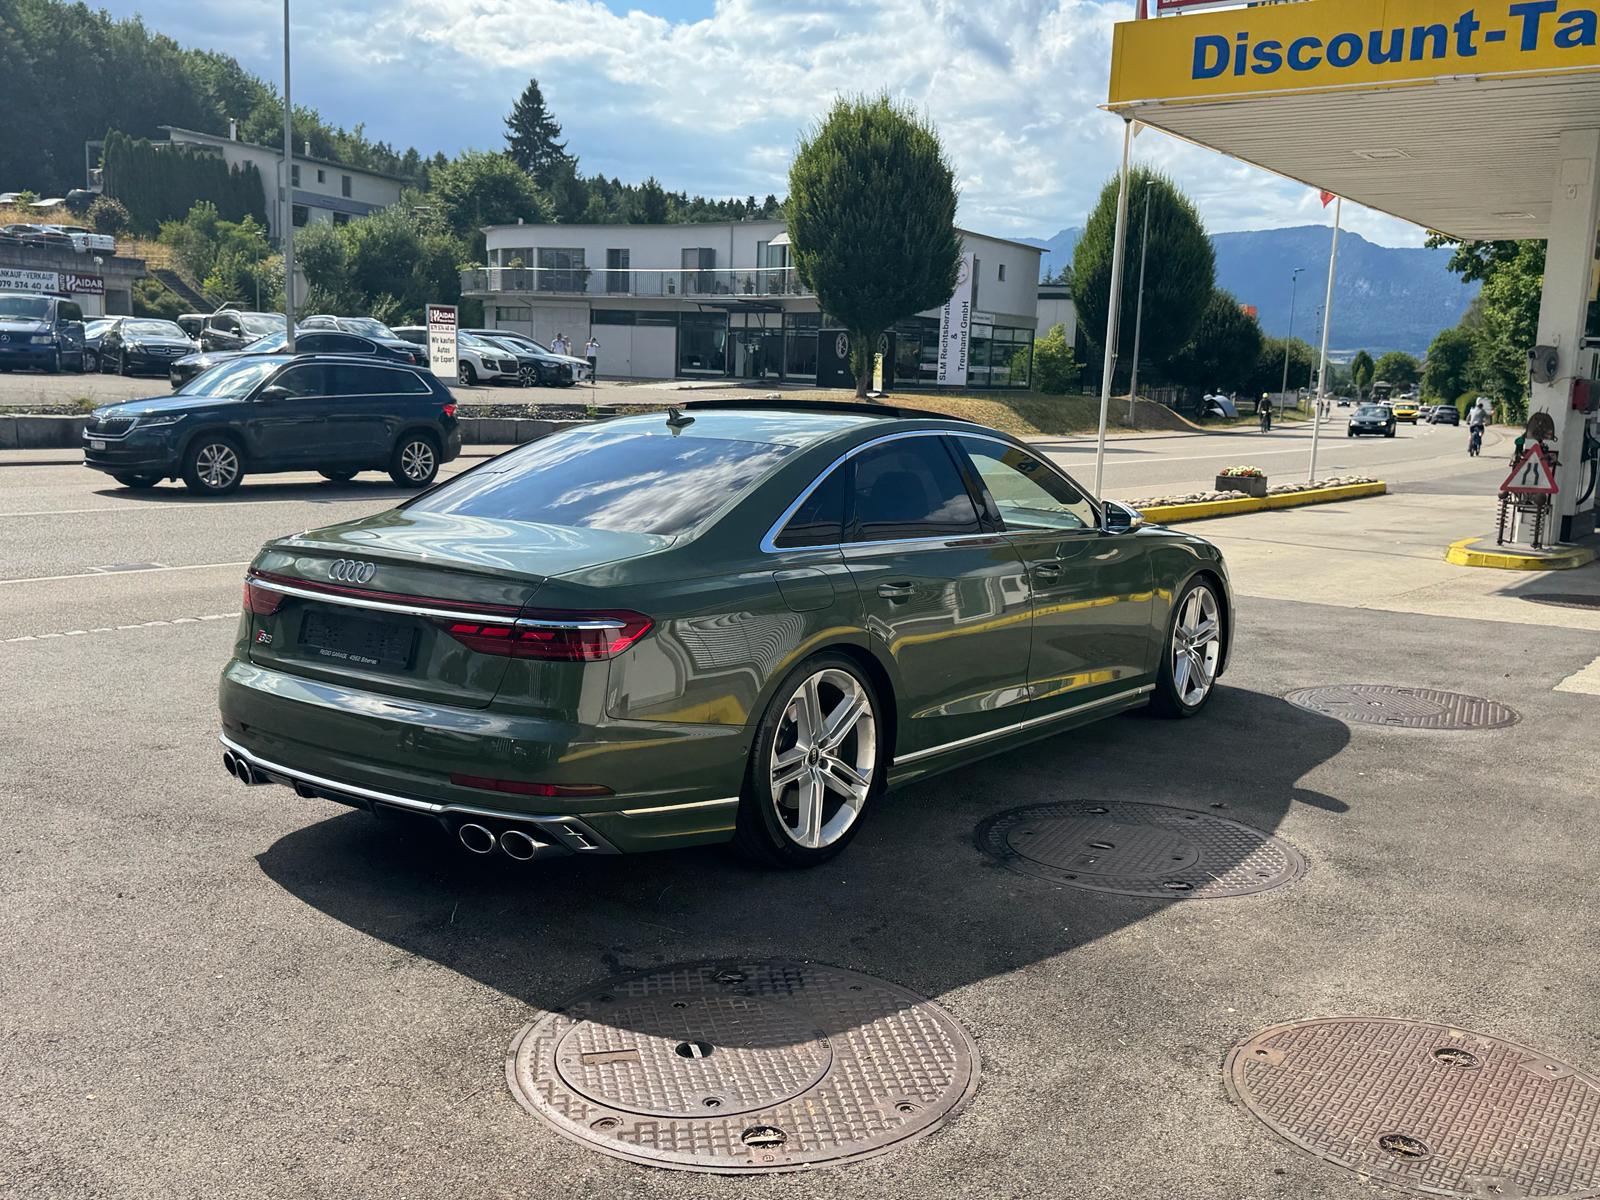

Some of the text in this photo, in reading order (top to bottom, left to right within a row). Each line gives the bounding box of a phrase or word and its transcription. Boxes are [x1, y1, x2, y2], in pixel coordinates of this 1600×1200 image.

[14, 281, 28, 289] 574
[31, 282, 42, 290] 40
[66, 275, 103, 291] HAIDAR
[939, 298, 951, 381] SLM Rechtsberatu
[958, 301, 969, 372] Treuhand GmbH
